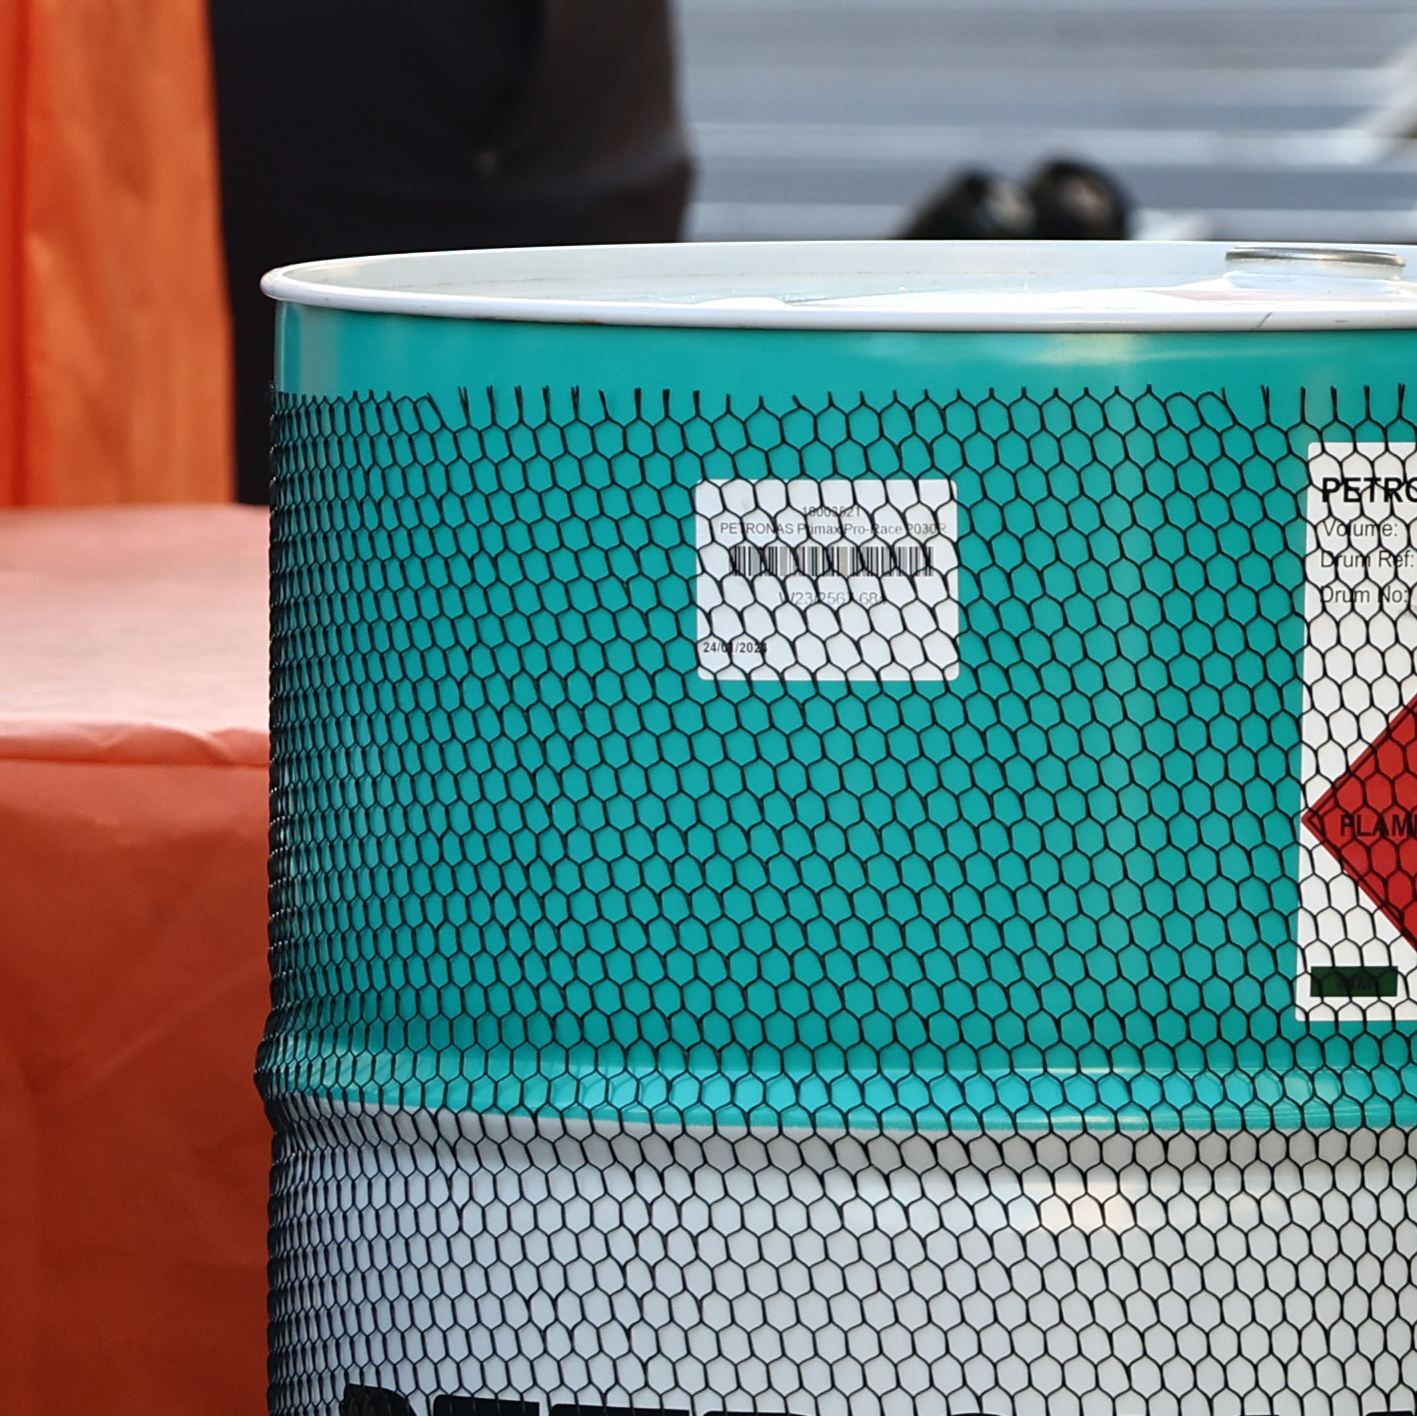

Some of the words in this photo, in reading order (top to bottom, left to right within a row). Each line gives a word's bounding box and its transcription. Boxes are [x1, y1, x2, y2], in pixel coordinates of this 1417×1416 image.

[720, 522, 794, 534] PETRONAS
[797, 522, 842, 534] Pimax
[1322, 519, 1398, 537] Voume:
[1320, 550, 1371, 568] Drum
[1378, 550, 1415, 568] Ref:
[1321, 586, 1371, 603] Drum
[1378, 585, 1409, 603] No:
